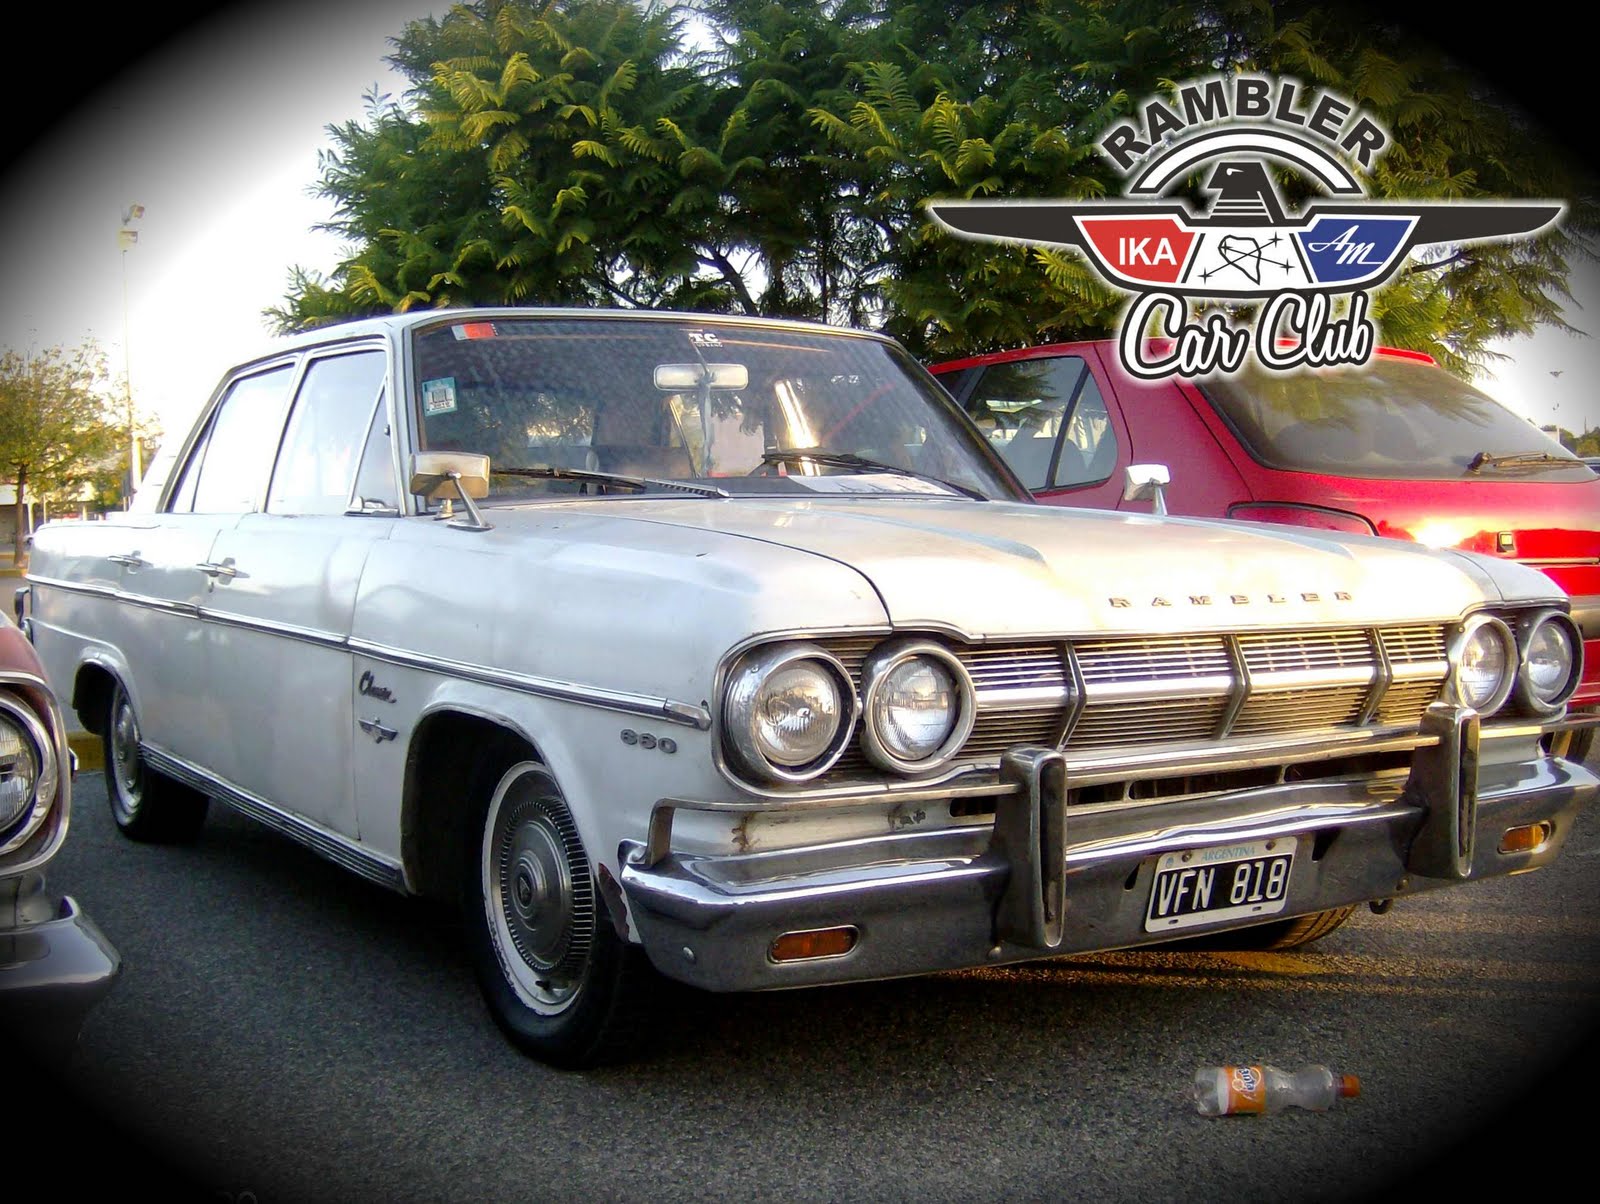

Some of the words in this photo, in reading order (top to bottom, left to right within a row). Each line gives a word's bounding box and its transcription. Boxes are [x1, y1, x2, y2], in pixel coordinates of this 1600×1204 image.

[1108, 591, 1352, 608] RAMBLER
[1202, 847, 1256, 862] ARGENTINA
[1158, 867, 1216, 916] VFN
[1230, 858, 1288, 905] 818
